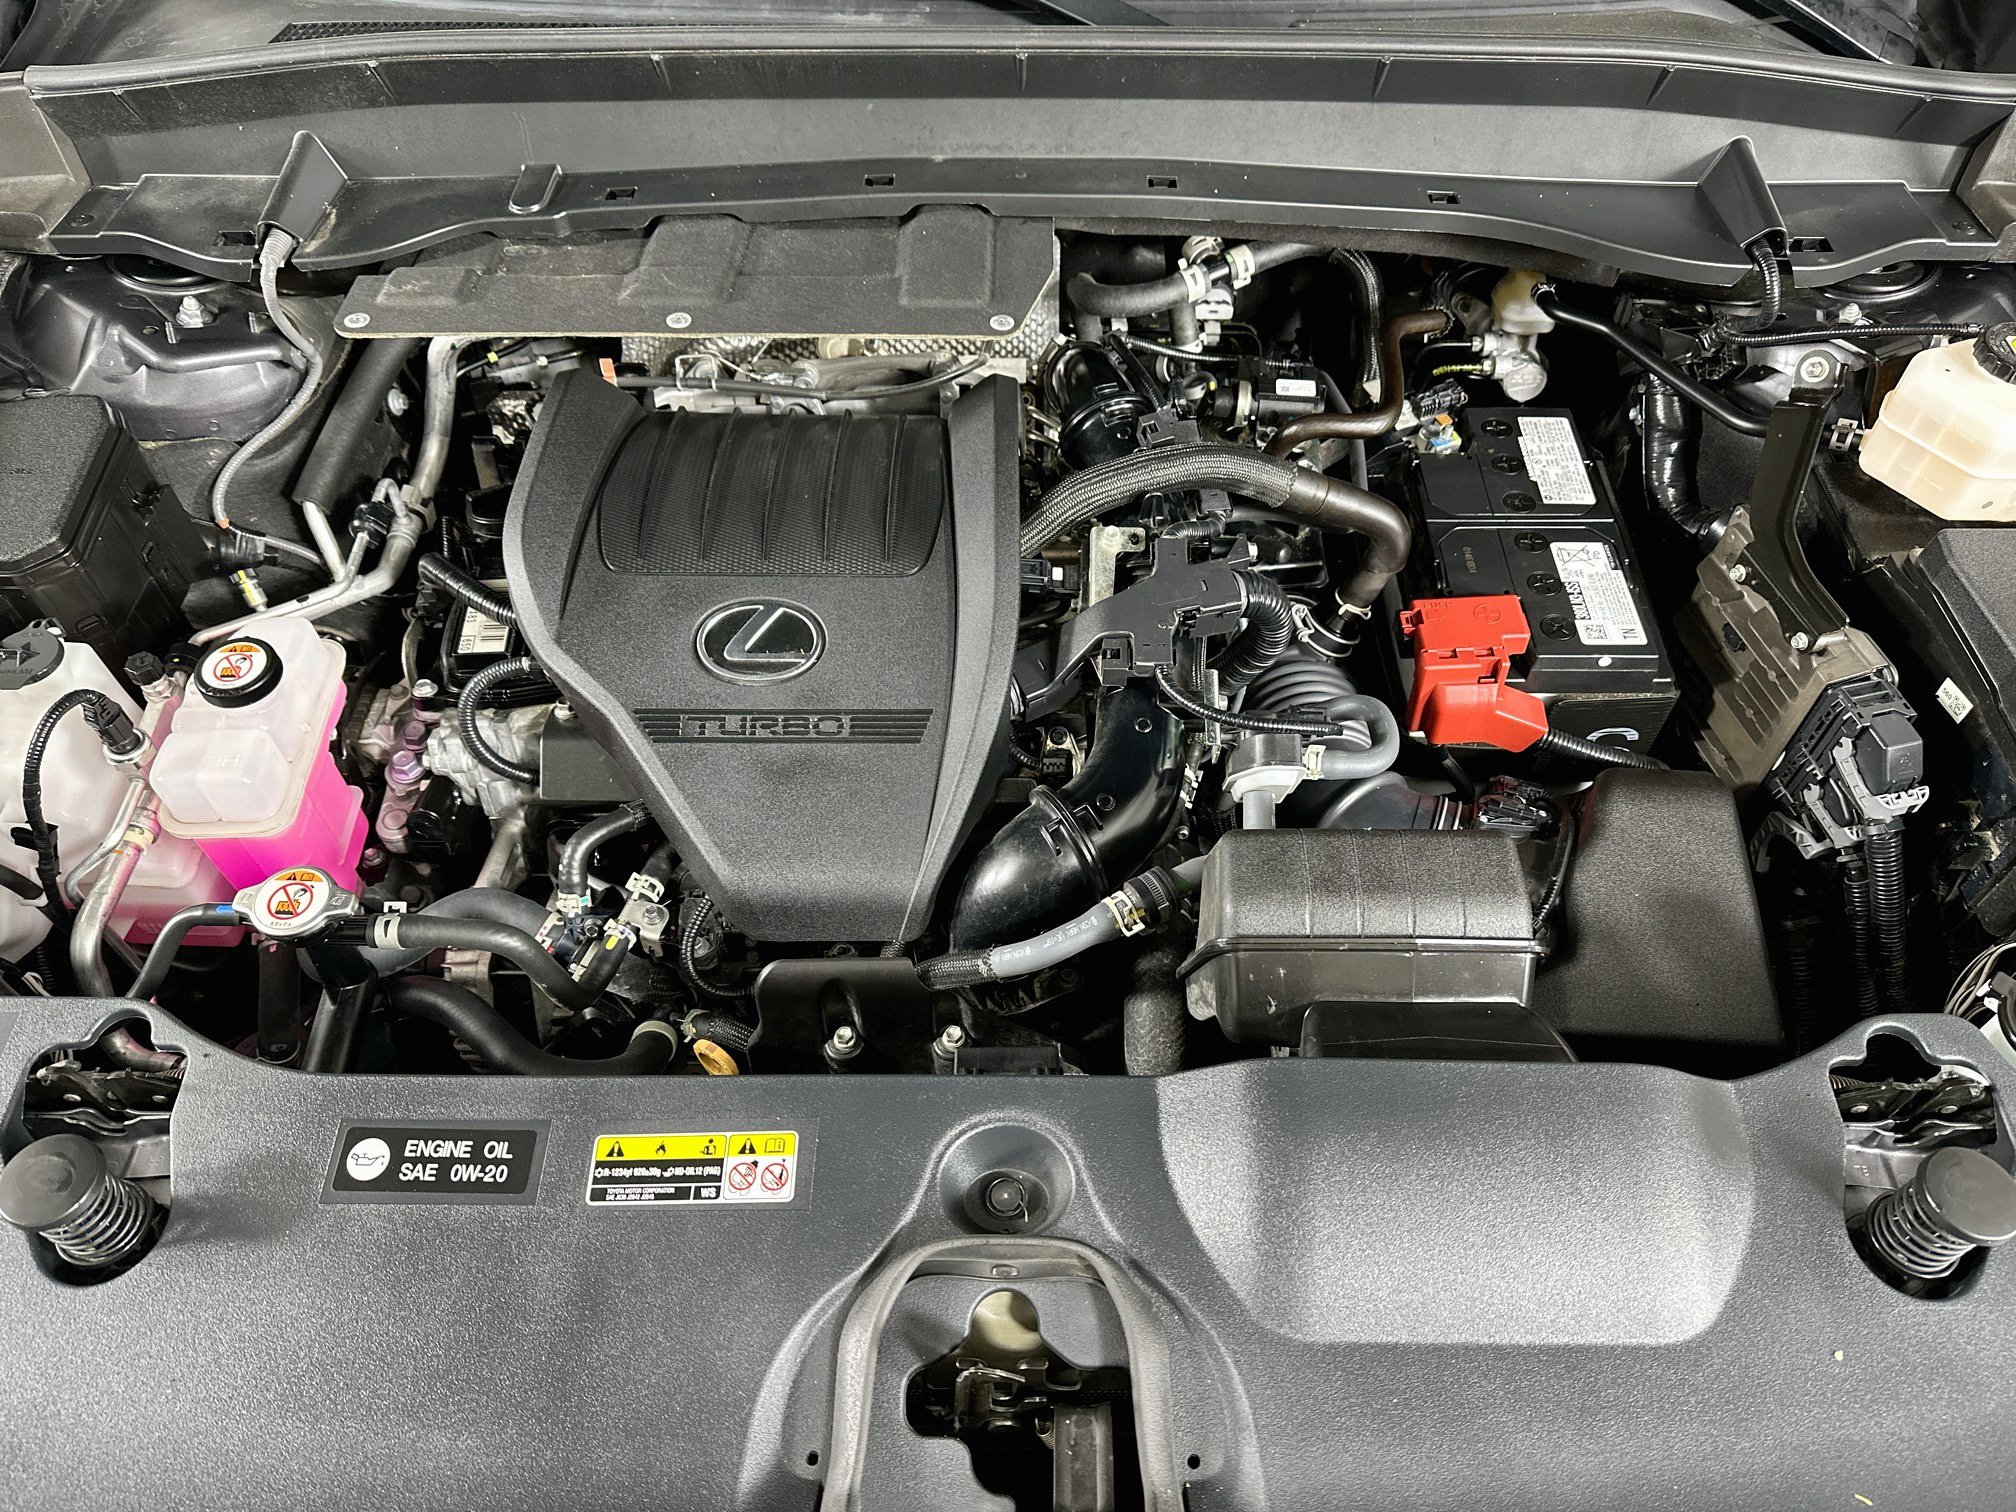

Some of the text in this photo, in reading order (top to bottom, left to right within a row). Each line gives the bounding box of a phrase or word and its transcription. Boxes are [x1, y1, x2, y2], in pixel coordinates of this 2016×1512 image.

[1423, 601, 1453, 609] PUSH
[686, 714, 846, 737] TURBO
[403, 1139, 514, 1159] ENGINE OIL
[398, 1163, 508, 1183] SAE 0W-20
[607, 1187, 625, 1195] TOYOTA
[642, 1186, 675, 1194] CORPORATION
[700, 1186, 717, 1198] WS
